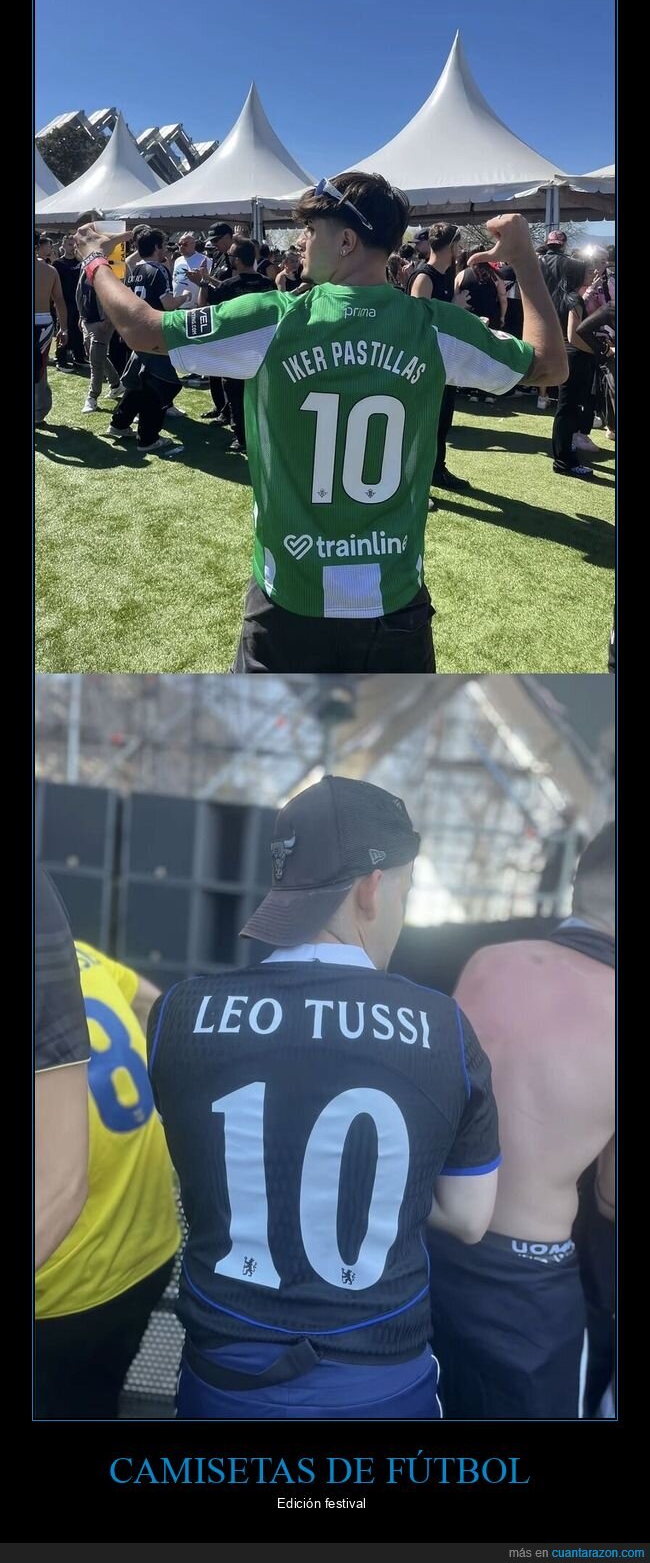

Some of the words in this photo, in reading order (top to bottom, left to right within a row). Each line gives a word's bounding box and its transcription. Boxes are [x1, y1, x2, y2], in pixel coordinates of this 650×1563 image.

[343, 307, 377, 319] prima
[282, 346, 328, 384] IKER
[331, 340, 426, 385] PASTILLAS
[299, 391, 406, 504] 10
[193, 995, 283, 1035] LEO
[305, 999, 431, 1049] TUSSI
[212, 1081, 410, 1291] 10
